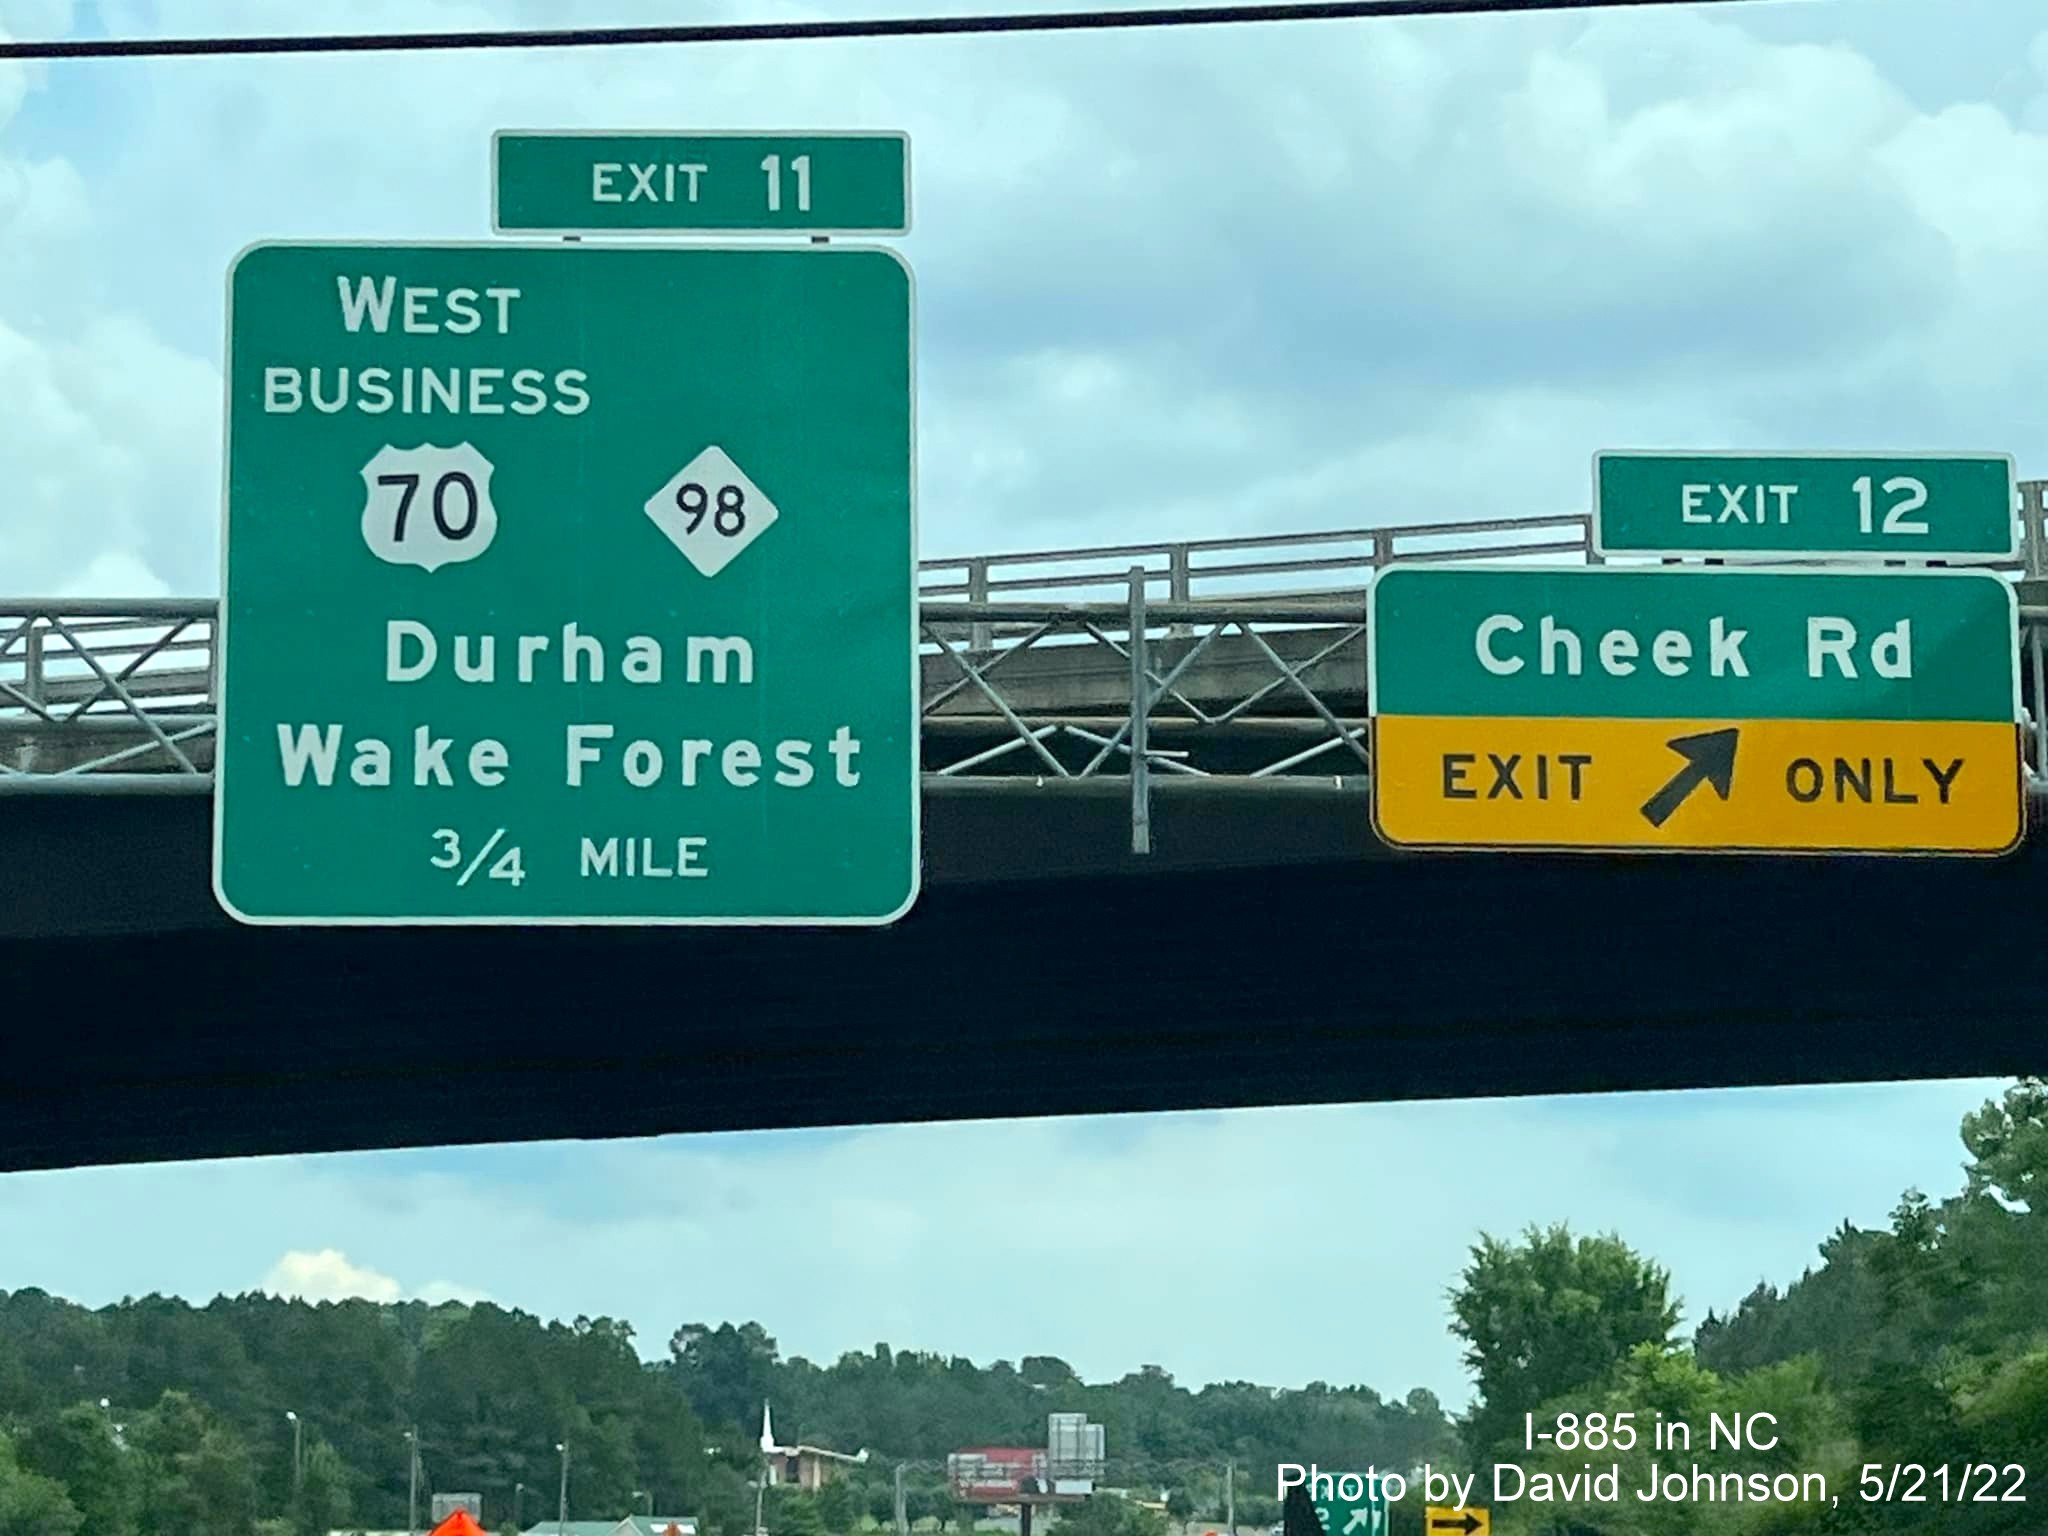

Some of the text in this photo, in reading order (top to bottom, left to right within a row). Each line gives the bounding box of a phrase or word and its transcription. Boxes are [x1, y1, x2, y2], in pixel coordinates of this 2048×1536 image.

[593, 155, 811, 211] EXIT 11
[338, 276, 520, 334] WEST
[265, 367, 590, 414] BUSINESS
[377, 472, 478, 542] 70
[675, 483, 746, 537] 98
[1682, 476, 1929, 534] EXIT 12
[387, 620, 753, 683] Durham
[1476, 614, 1912, 678] Cheek Rd
[277, 723, 861, 787] Wake Forest
[1442, 753, 1964, 805] EXIT ONLY
[430, 829, 708, 886] 3/4 MILE
